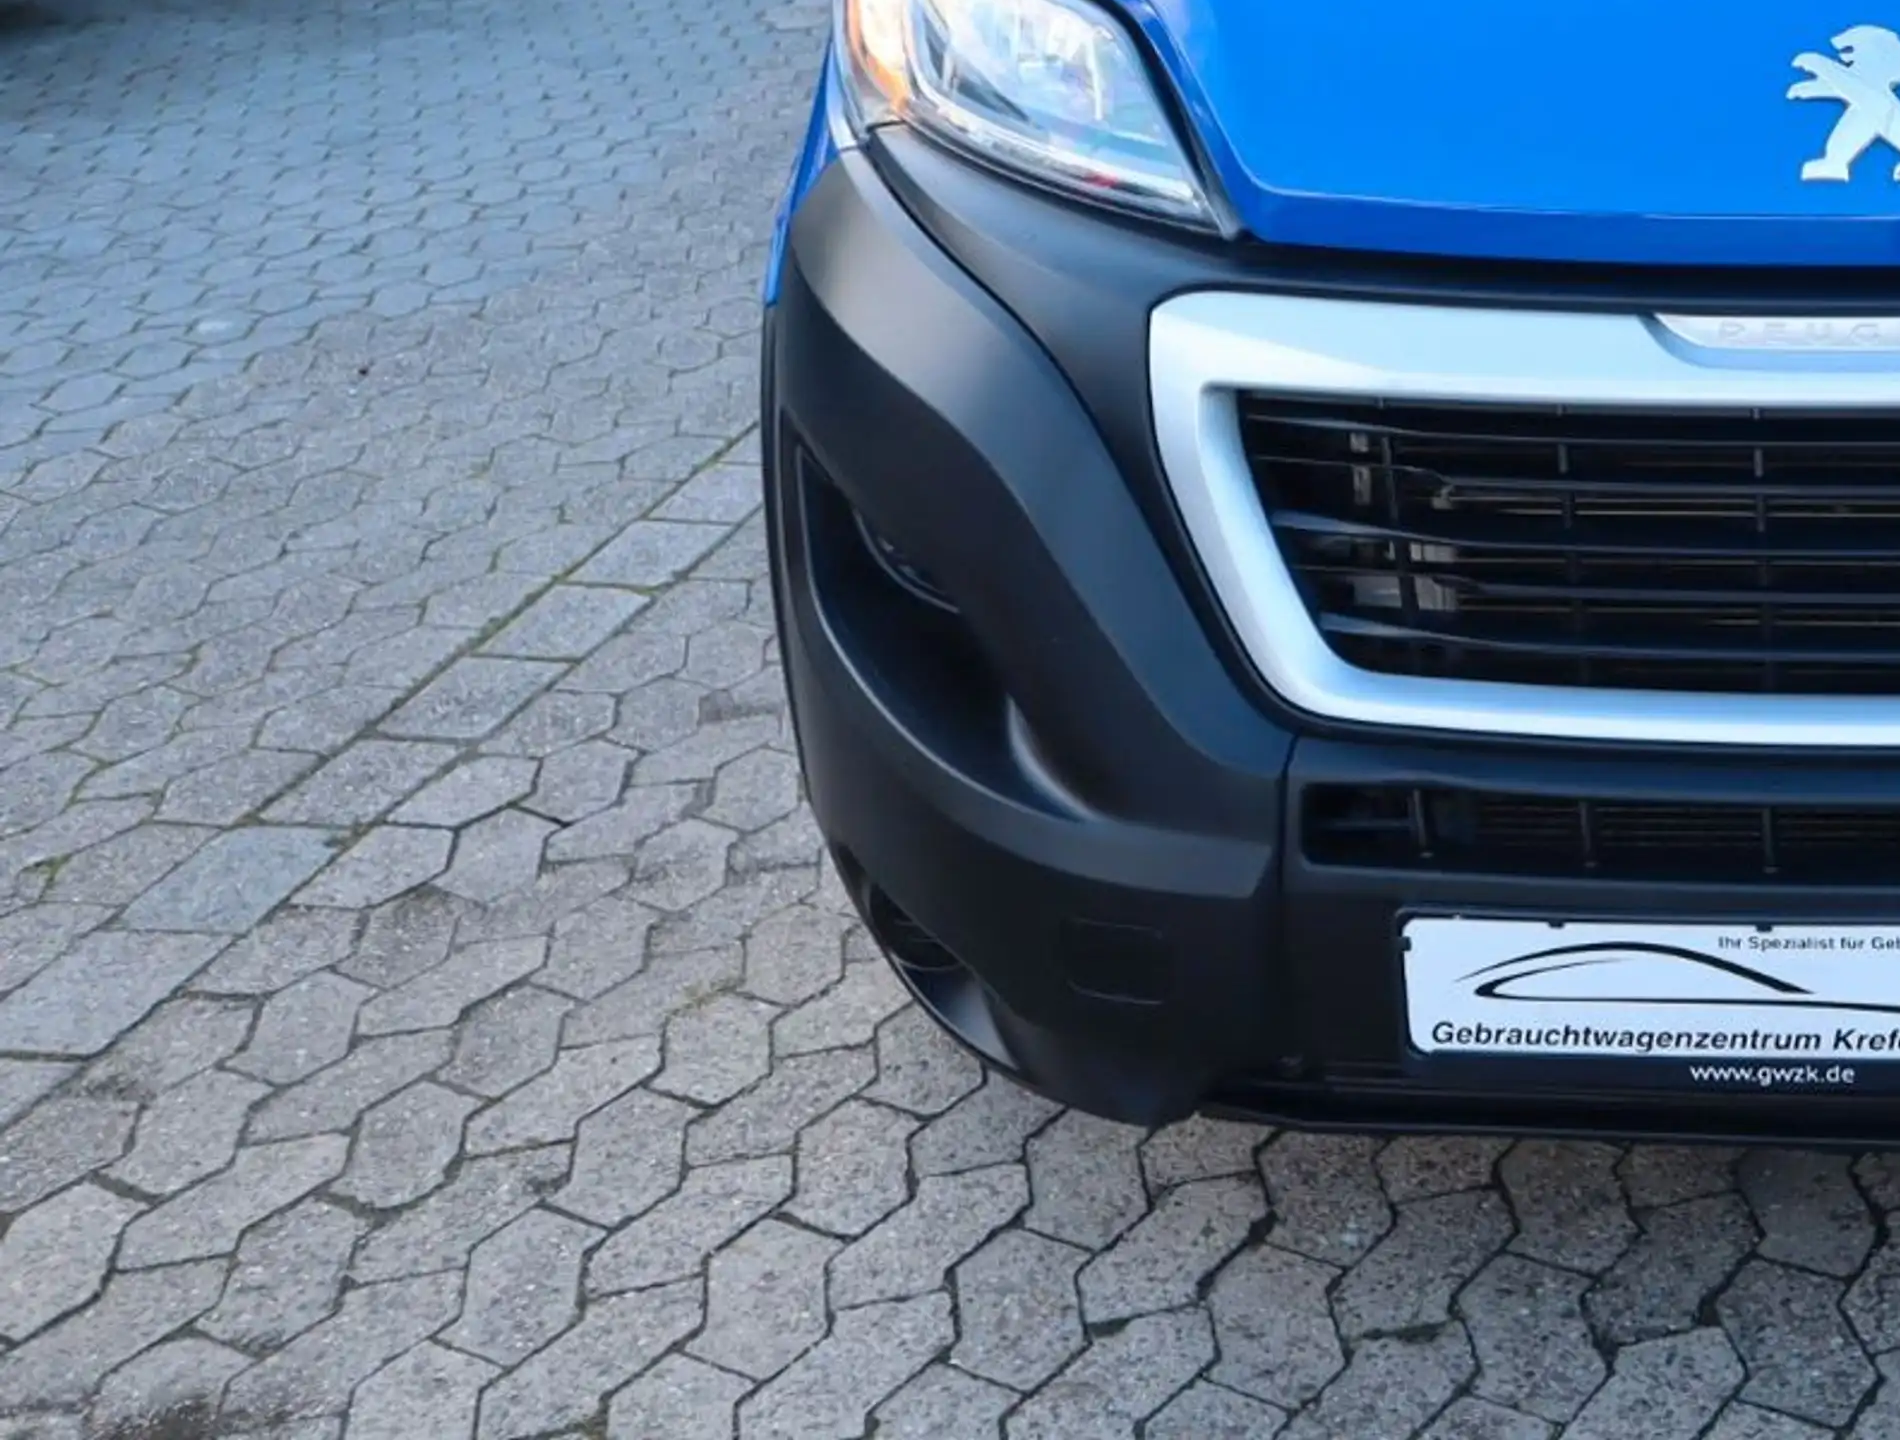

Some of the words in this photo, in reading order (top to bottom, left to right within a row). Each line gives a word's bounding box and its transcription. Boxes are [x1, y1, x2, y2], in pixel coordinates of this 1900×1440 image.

[1718, 936, 1741, 950] Ihr
[1748, 936, 1835, 952] Spezialist
[1432, 1021, 1821, 1052] Gebrauchtwagenzentrum
[1690, 1063, 1855, 1085] www.gwzk.de
